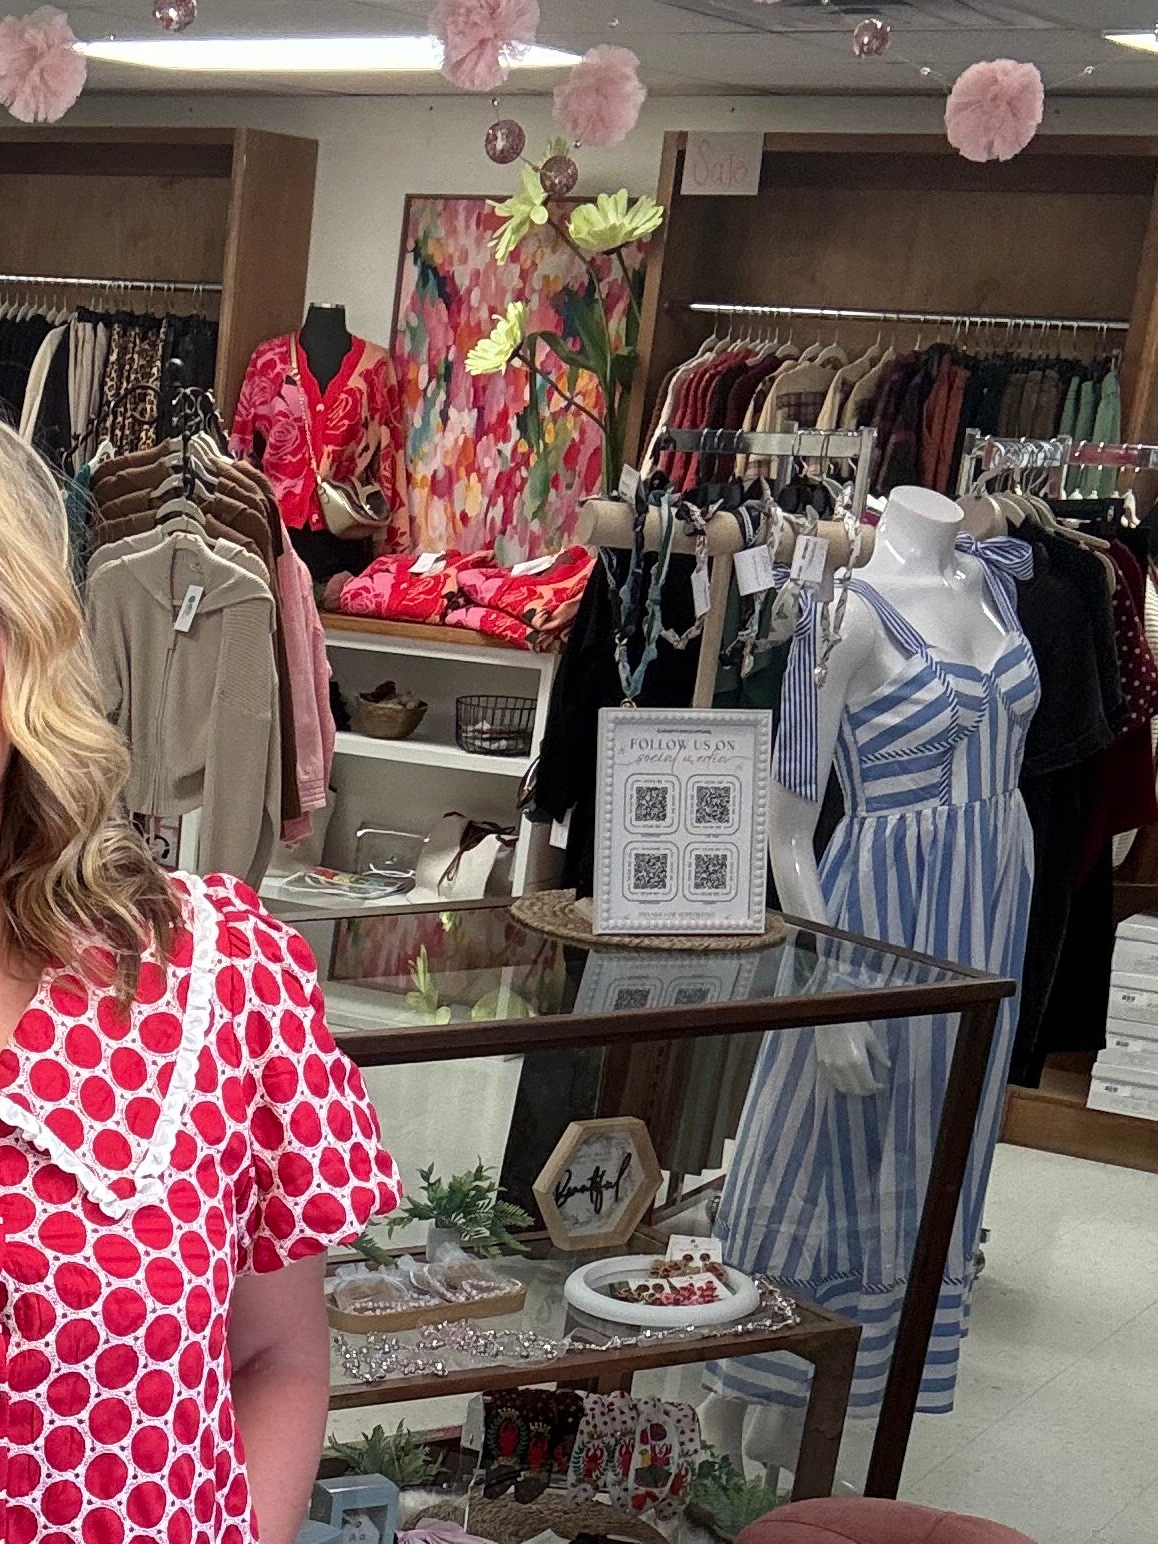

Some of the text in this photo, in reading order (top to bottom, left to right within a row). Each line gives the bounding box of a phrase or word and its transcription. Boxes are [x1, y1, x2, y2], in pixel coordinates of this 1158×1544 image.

[630, 738, 736, 751] FOLLOW US ON
